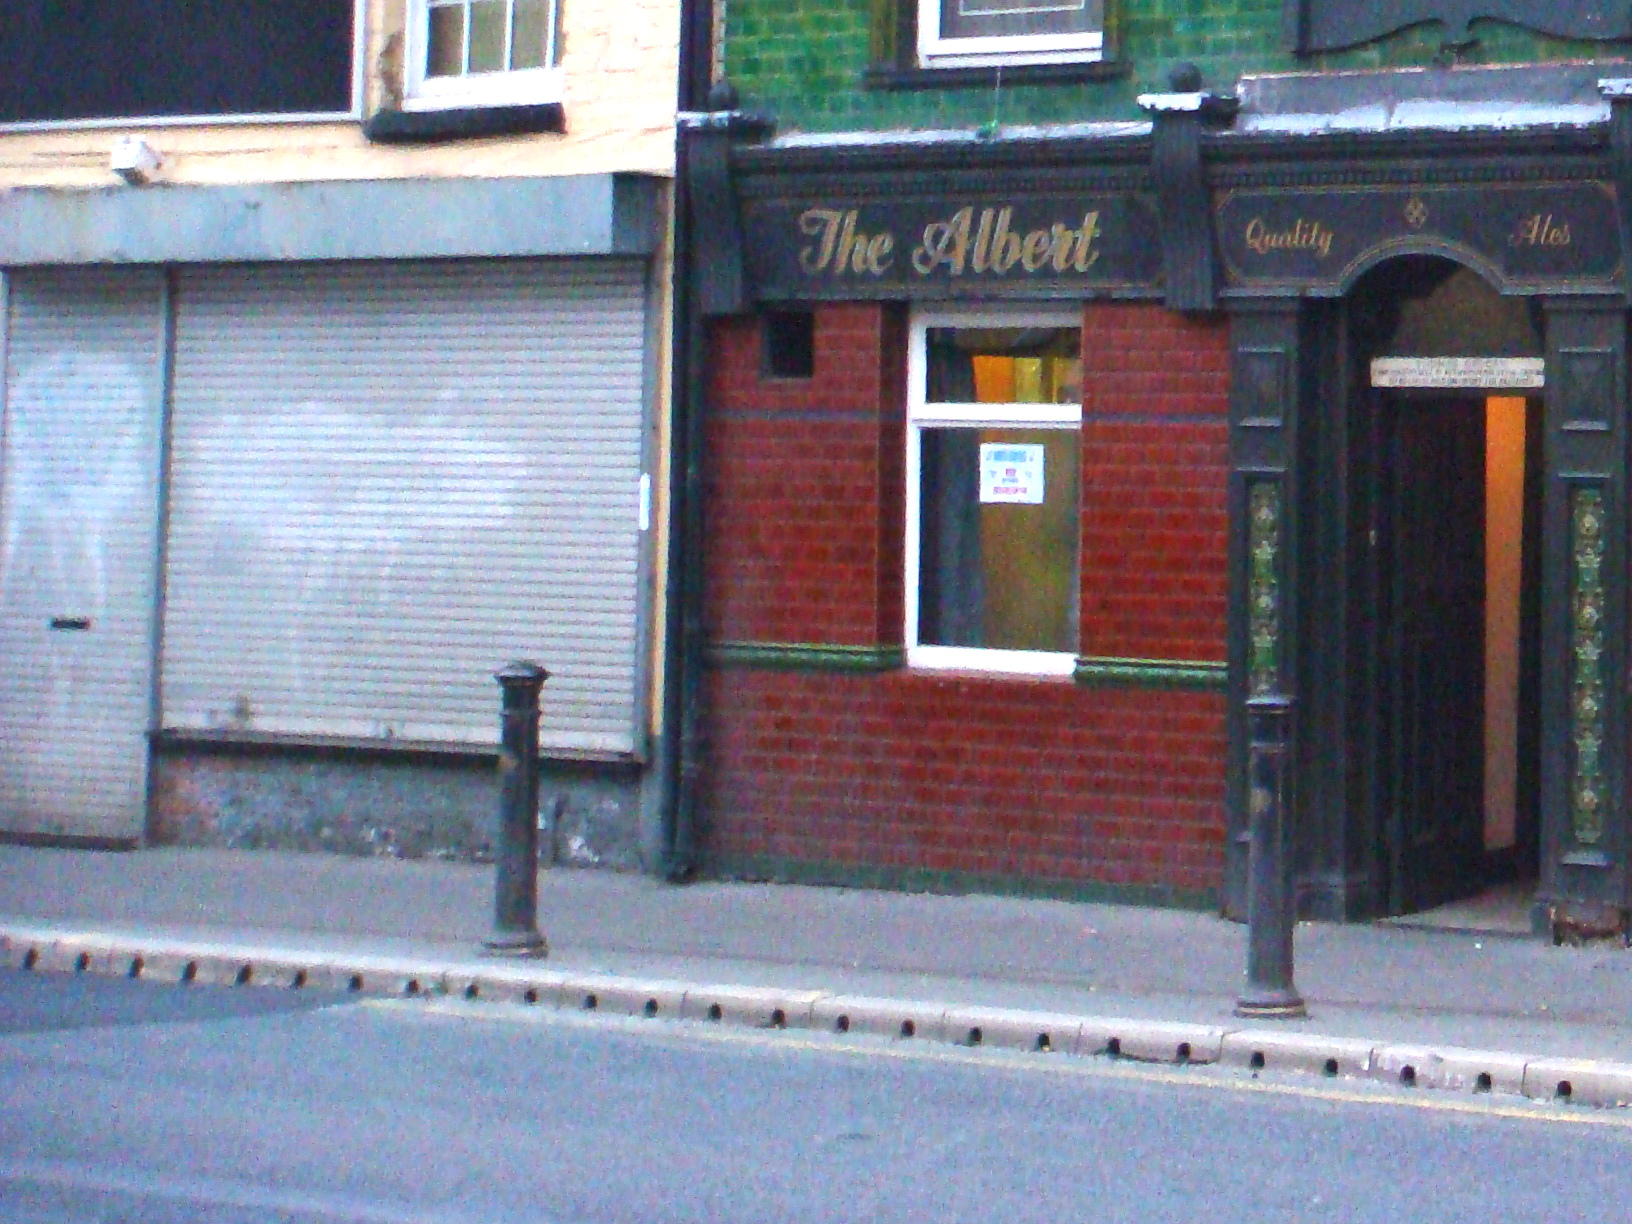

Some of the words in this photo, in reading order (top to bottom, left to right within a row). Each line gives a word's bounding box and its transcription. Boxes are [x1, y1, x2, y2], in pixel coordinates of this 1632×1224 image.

[799, 207, 895, 275] The
[912, 206, 1100, 276] Albert
[1245, 217, 1334, 256] Quality
[1511, 213, 1572, 247] Ales
